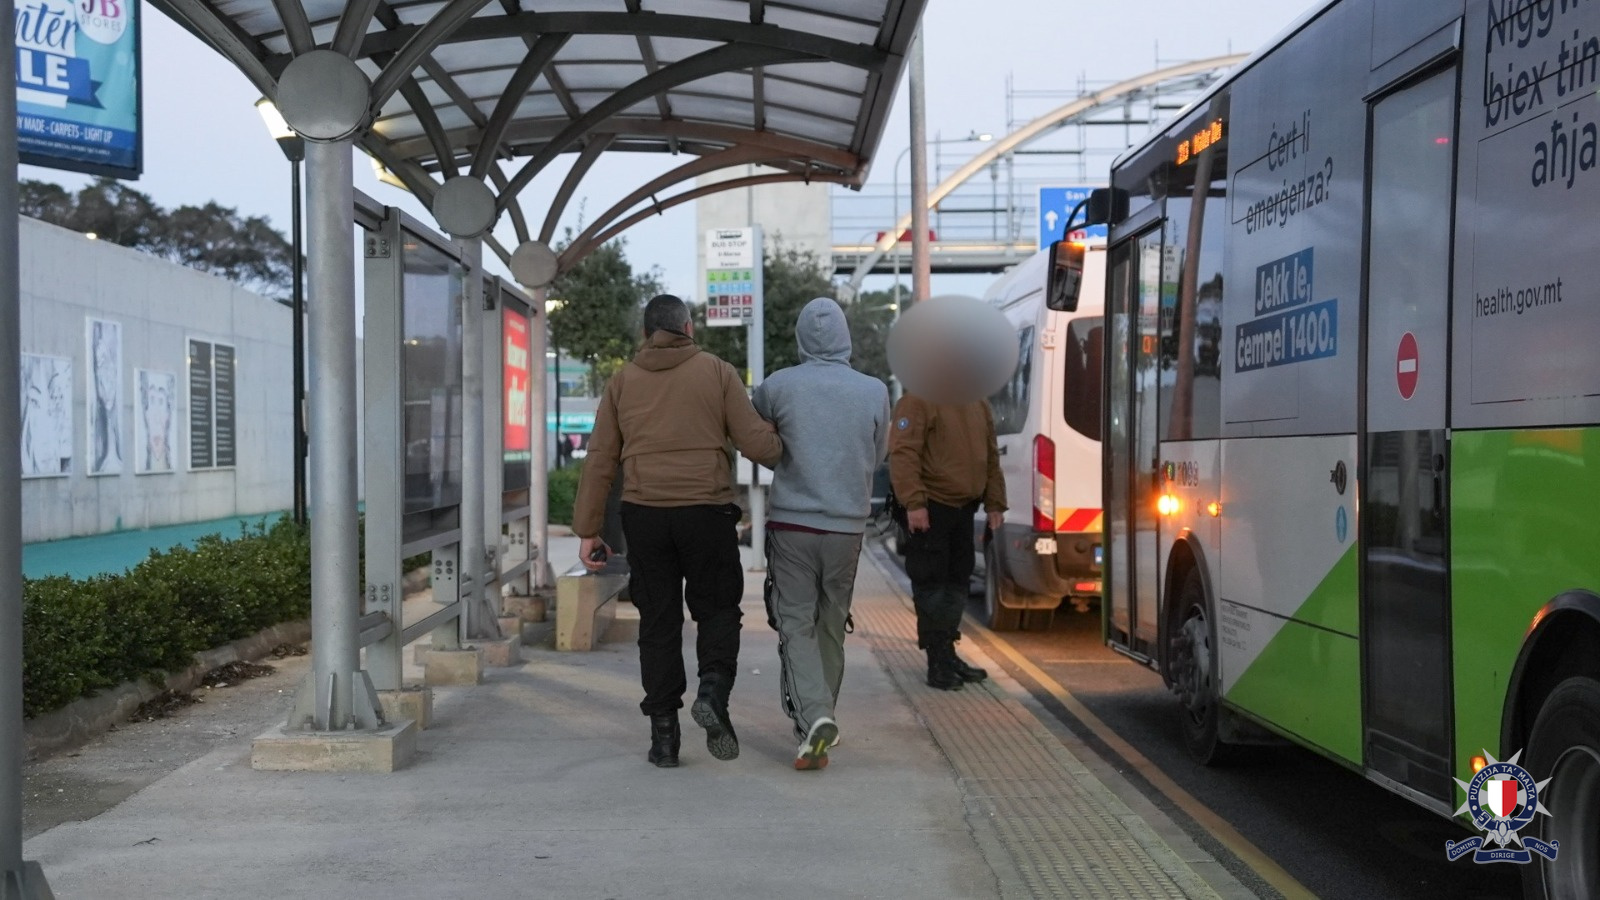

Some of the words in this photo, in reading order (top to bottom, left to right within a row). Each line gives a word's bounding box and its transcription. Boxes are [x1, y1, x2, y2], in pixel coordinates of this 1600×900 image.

[15, 2, 79, 50] nter
[81, 14, 122, 32] STORES
[16, 48, 70, 90] LE
[1485, 60, 1548, 129] biex
[24, 118, 45, 133] MADE
[50, 121, 80, 138] CARPETS
[84, 127, 103, 142] LIGHT
[103, 131, 113, 143] UP
[1268, 121, 1298, 172] Ċert
[1302, 109, 1311, 154] li
[1531, 112, 1598, 190] aħja
[1246, 157, 1333, 235] emerġenza?
[1256, 262, 1290, 311] Jekk
[1293, 257, 1311, 304] le,
[1476, 277, 1562, 318] health.gov.mt
[1237, 317, 1286, 369] ċempel
[1289, 308, 1334, 358] 1400.
